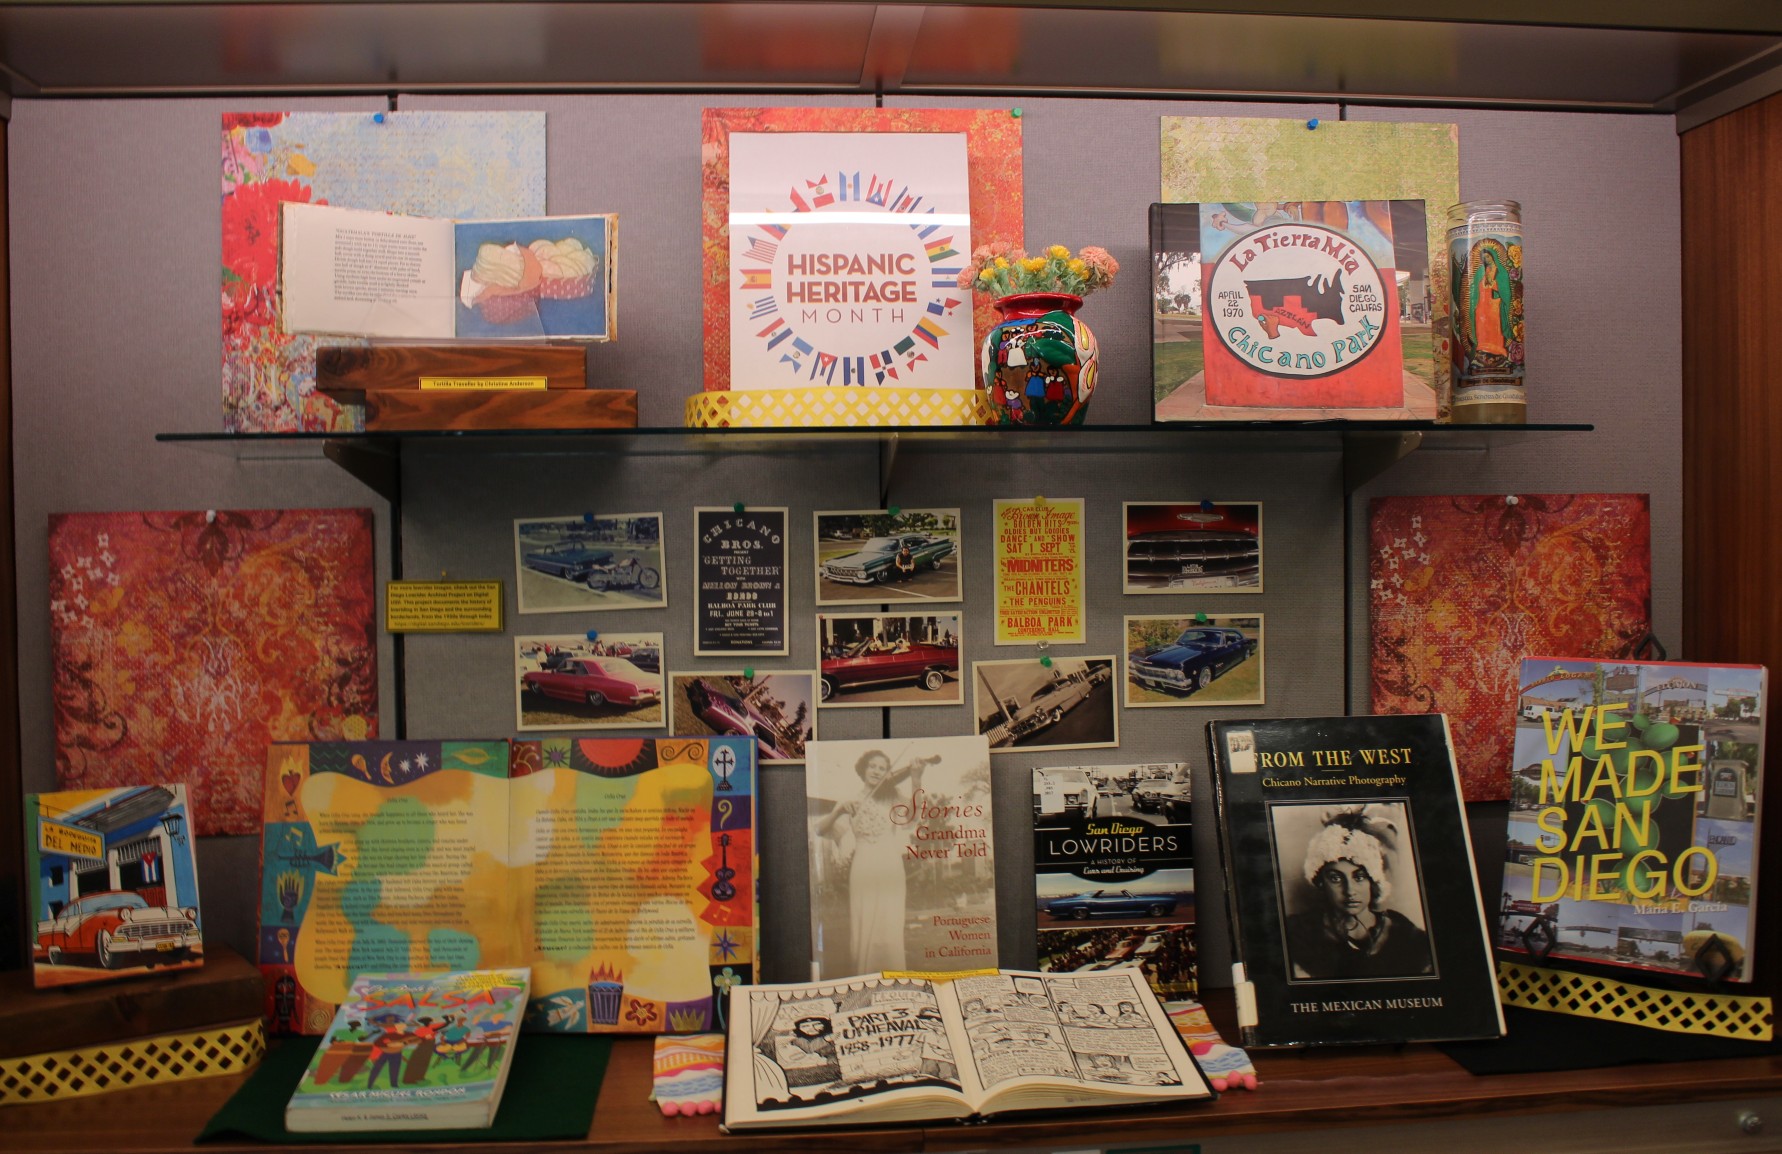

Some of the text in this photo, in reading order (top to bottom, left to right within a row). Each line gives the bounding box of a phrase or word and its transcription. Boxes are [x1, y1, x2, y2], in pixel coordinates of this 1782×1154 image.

[1230, 232, 1360, 276] La Tierra Mia
[787, 253, 916, 276] HISPANIC
[786, 280, 917, 304] HERITAGE
[1218, 290, 1244, 300] APRIL
[1352, 284, 1372, 293] SAN
[1227, 299, 1239, 308] 22
[1349, 294, 1377, 303] DIEGO
[1222, 307, 1244, 318] 1970
[1349, 302, 1383, 312] CALIFAS
[802, 308, 904, 324] MONTH
[1227, 314, 1380, 370] Chicano Park
[703, 518, 780, 544] CHICANO
[1014, 520, 1042, 528] GOLDEN
[720, 540, 764, 550] BROS.
[1006, 543, 1023, 554] SAT
[1040, 543, 1061, 553] SEPT
[1007, 559, 1074, 573] MIDNITERS
[1015, 580, 1070, 596] CHANTELS
[1010, 597, 1066, 606] THE PENGUINS
[1007, 617, 1073, 628] BALBOA PARK
[1541, 702, 1629, 755] WE
[1254, 749, 1411, 768] ROM THE WEST
[1262, 774, 1406, 787] Chicano Narrative Photography
[1538, 744, 1705, 805] MADE
[889, 788, 983, 826] Stories
[916, 824, 986, 841] Grandma
[1086, 822, 1145, 836] San Diego
[1534, 799, 1651, 854] SAN
[45, 835, 64, 849] DEL
[1049, 836, 1178, 856] LOWRIDERS
[905, 843, 987, 861] Never Told
[1116, 866, 1145, 875] Cruising
[1531, 845, 1718, 904] DIEGO
[933, 915, 990, 929] Portuguese
[949, 931, 991, 942] Women
[925, 944, 992, 959] in California
[360, 989, 496, 1012] SALSA
[1291, 998, 1444, 1013] THE MEXICAN MUSEUM
[847, 1007, 911, 1028] PART 3
[842, 1019, 929, 1040] UPHEAVAL
